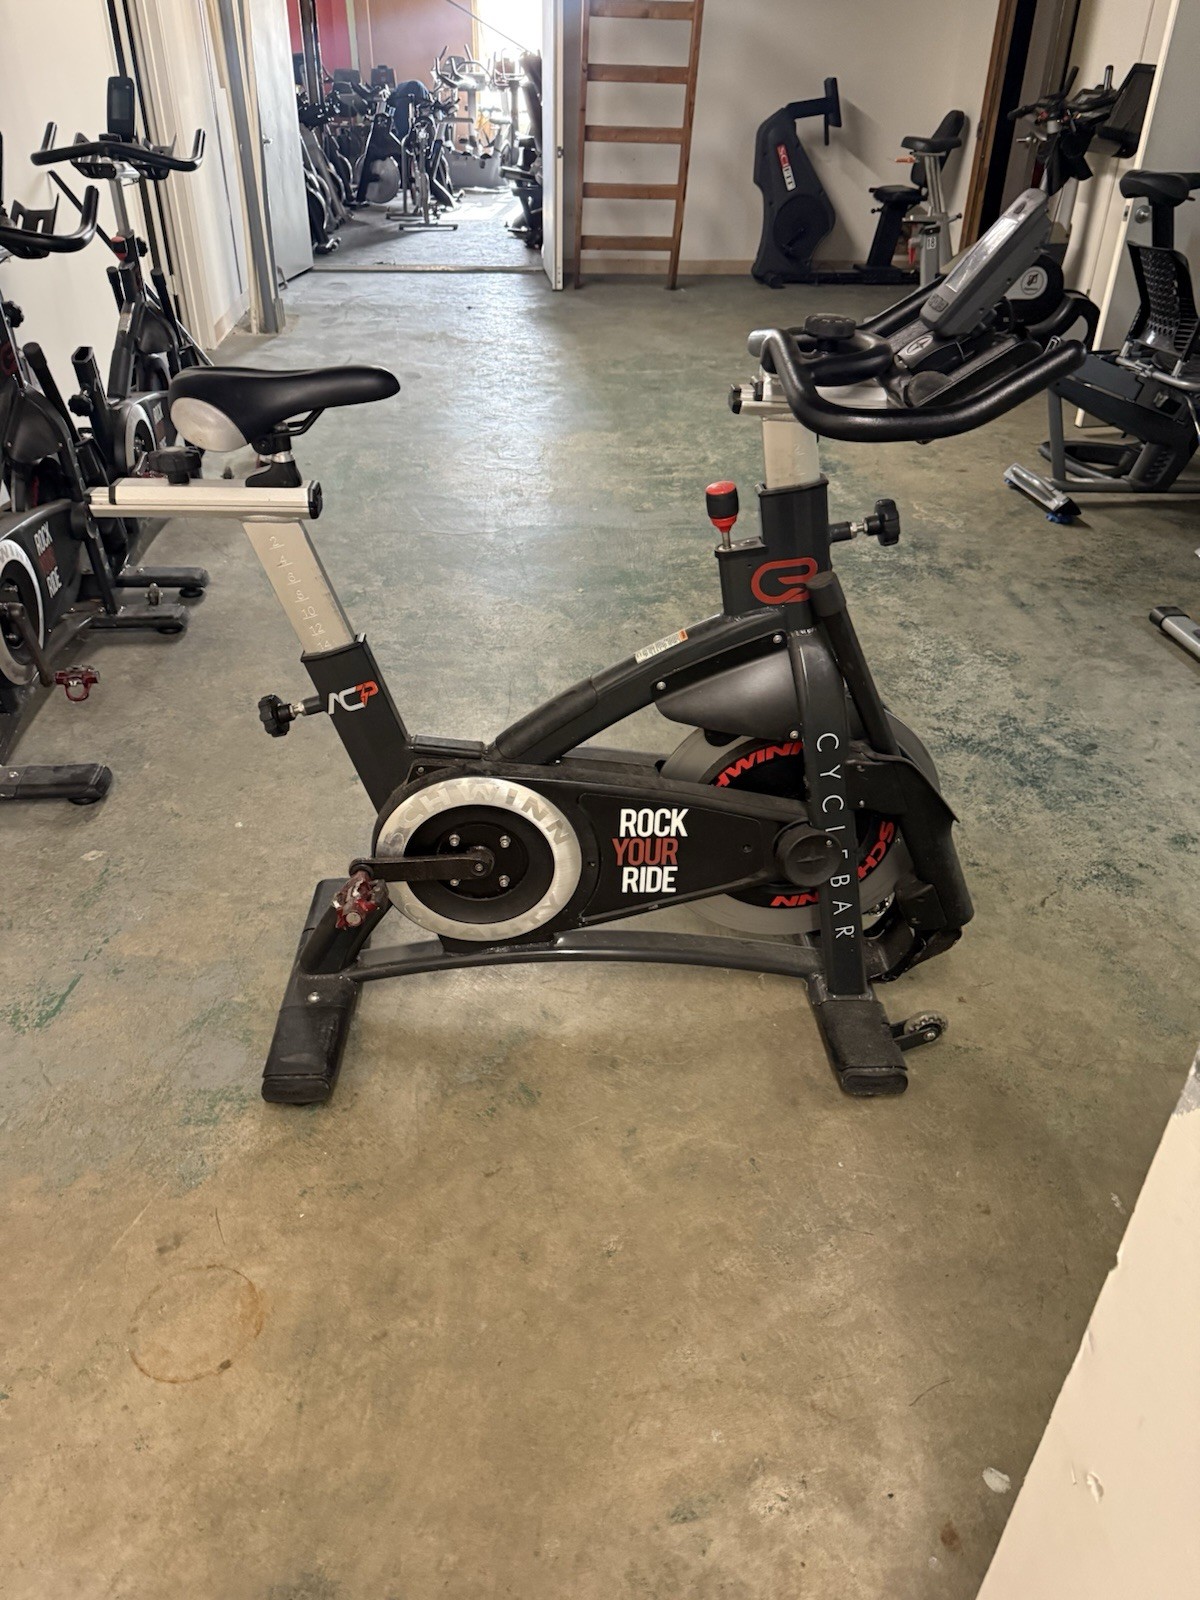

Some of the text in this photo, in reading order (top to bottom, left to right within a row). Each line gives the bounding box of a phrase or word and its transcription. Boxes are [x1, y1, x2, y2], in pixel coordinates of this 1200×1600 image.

[926, 236, 937, 249] 18
[301, 605, 316, 617] 10
[309, 623, 324, 634] 12
[619, 808, 690, 838] ROCK
[612, 837, 679, 866] YOUR
[621, 866, 679, 893] RIDE
